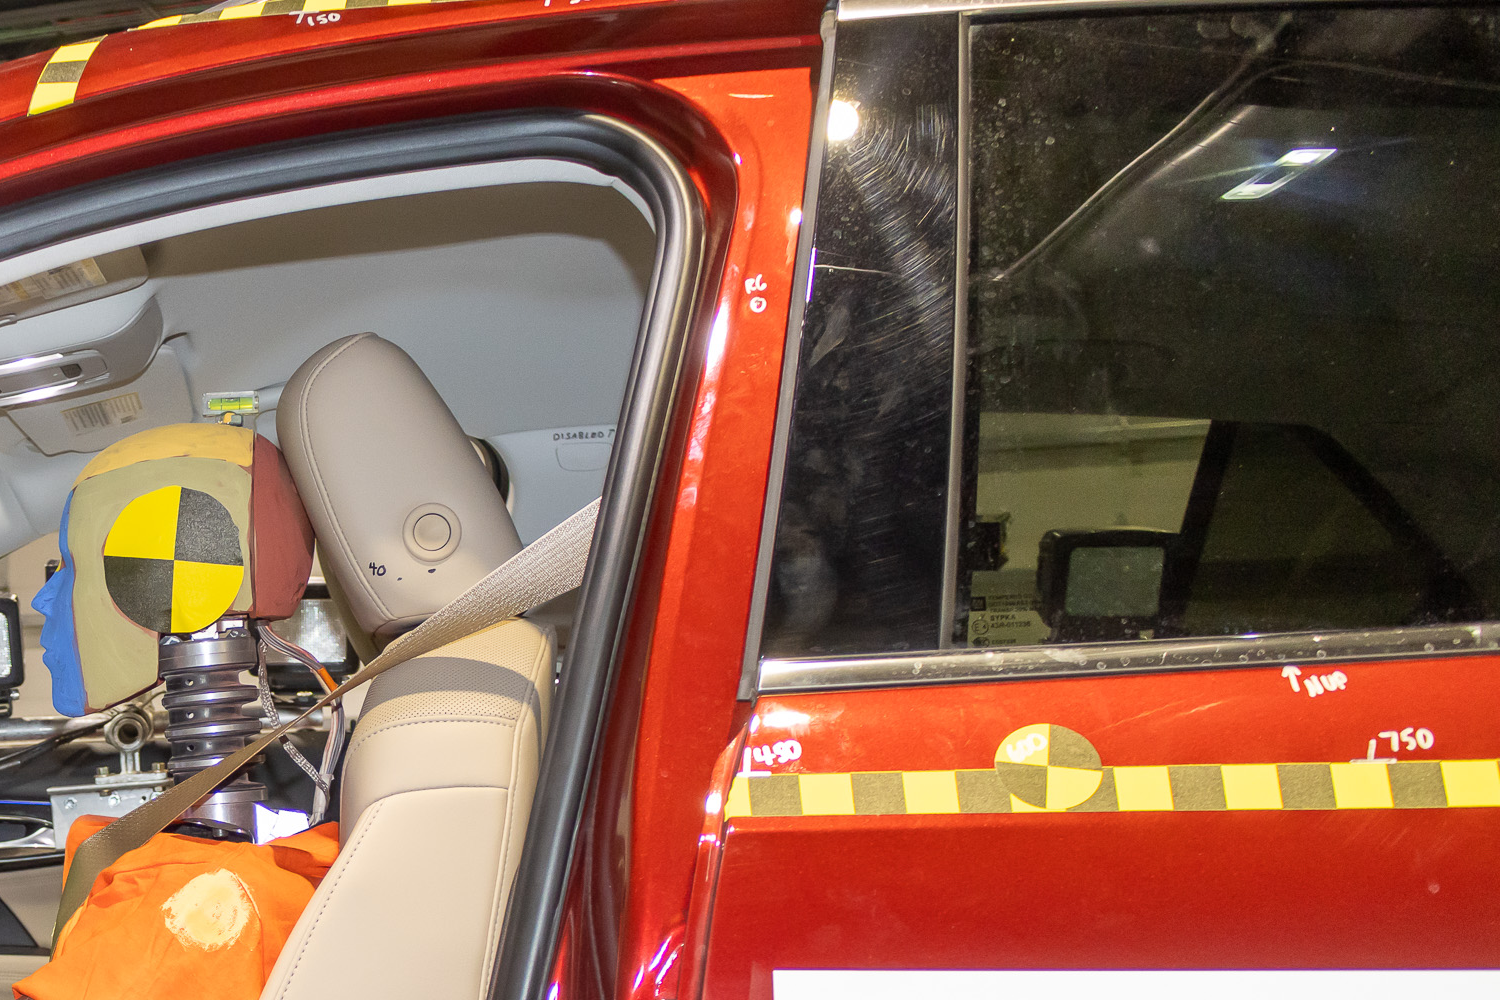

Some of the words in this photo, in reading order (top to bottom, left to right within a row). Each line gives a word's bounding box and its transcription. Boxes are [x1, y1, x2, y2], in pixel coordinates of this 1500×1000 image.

[552, 430, 605, 441] DISABLED
[368, 561, 387, 577] 40
[1377, 727, 1434, 752] 750
